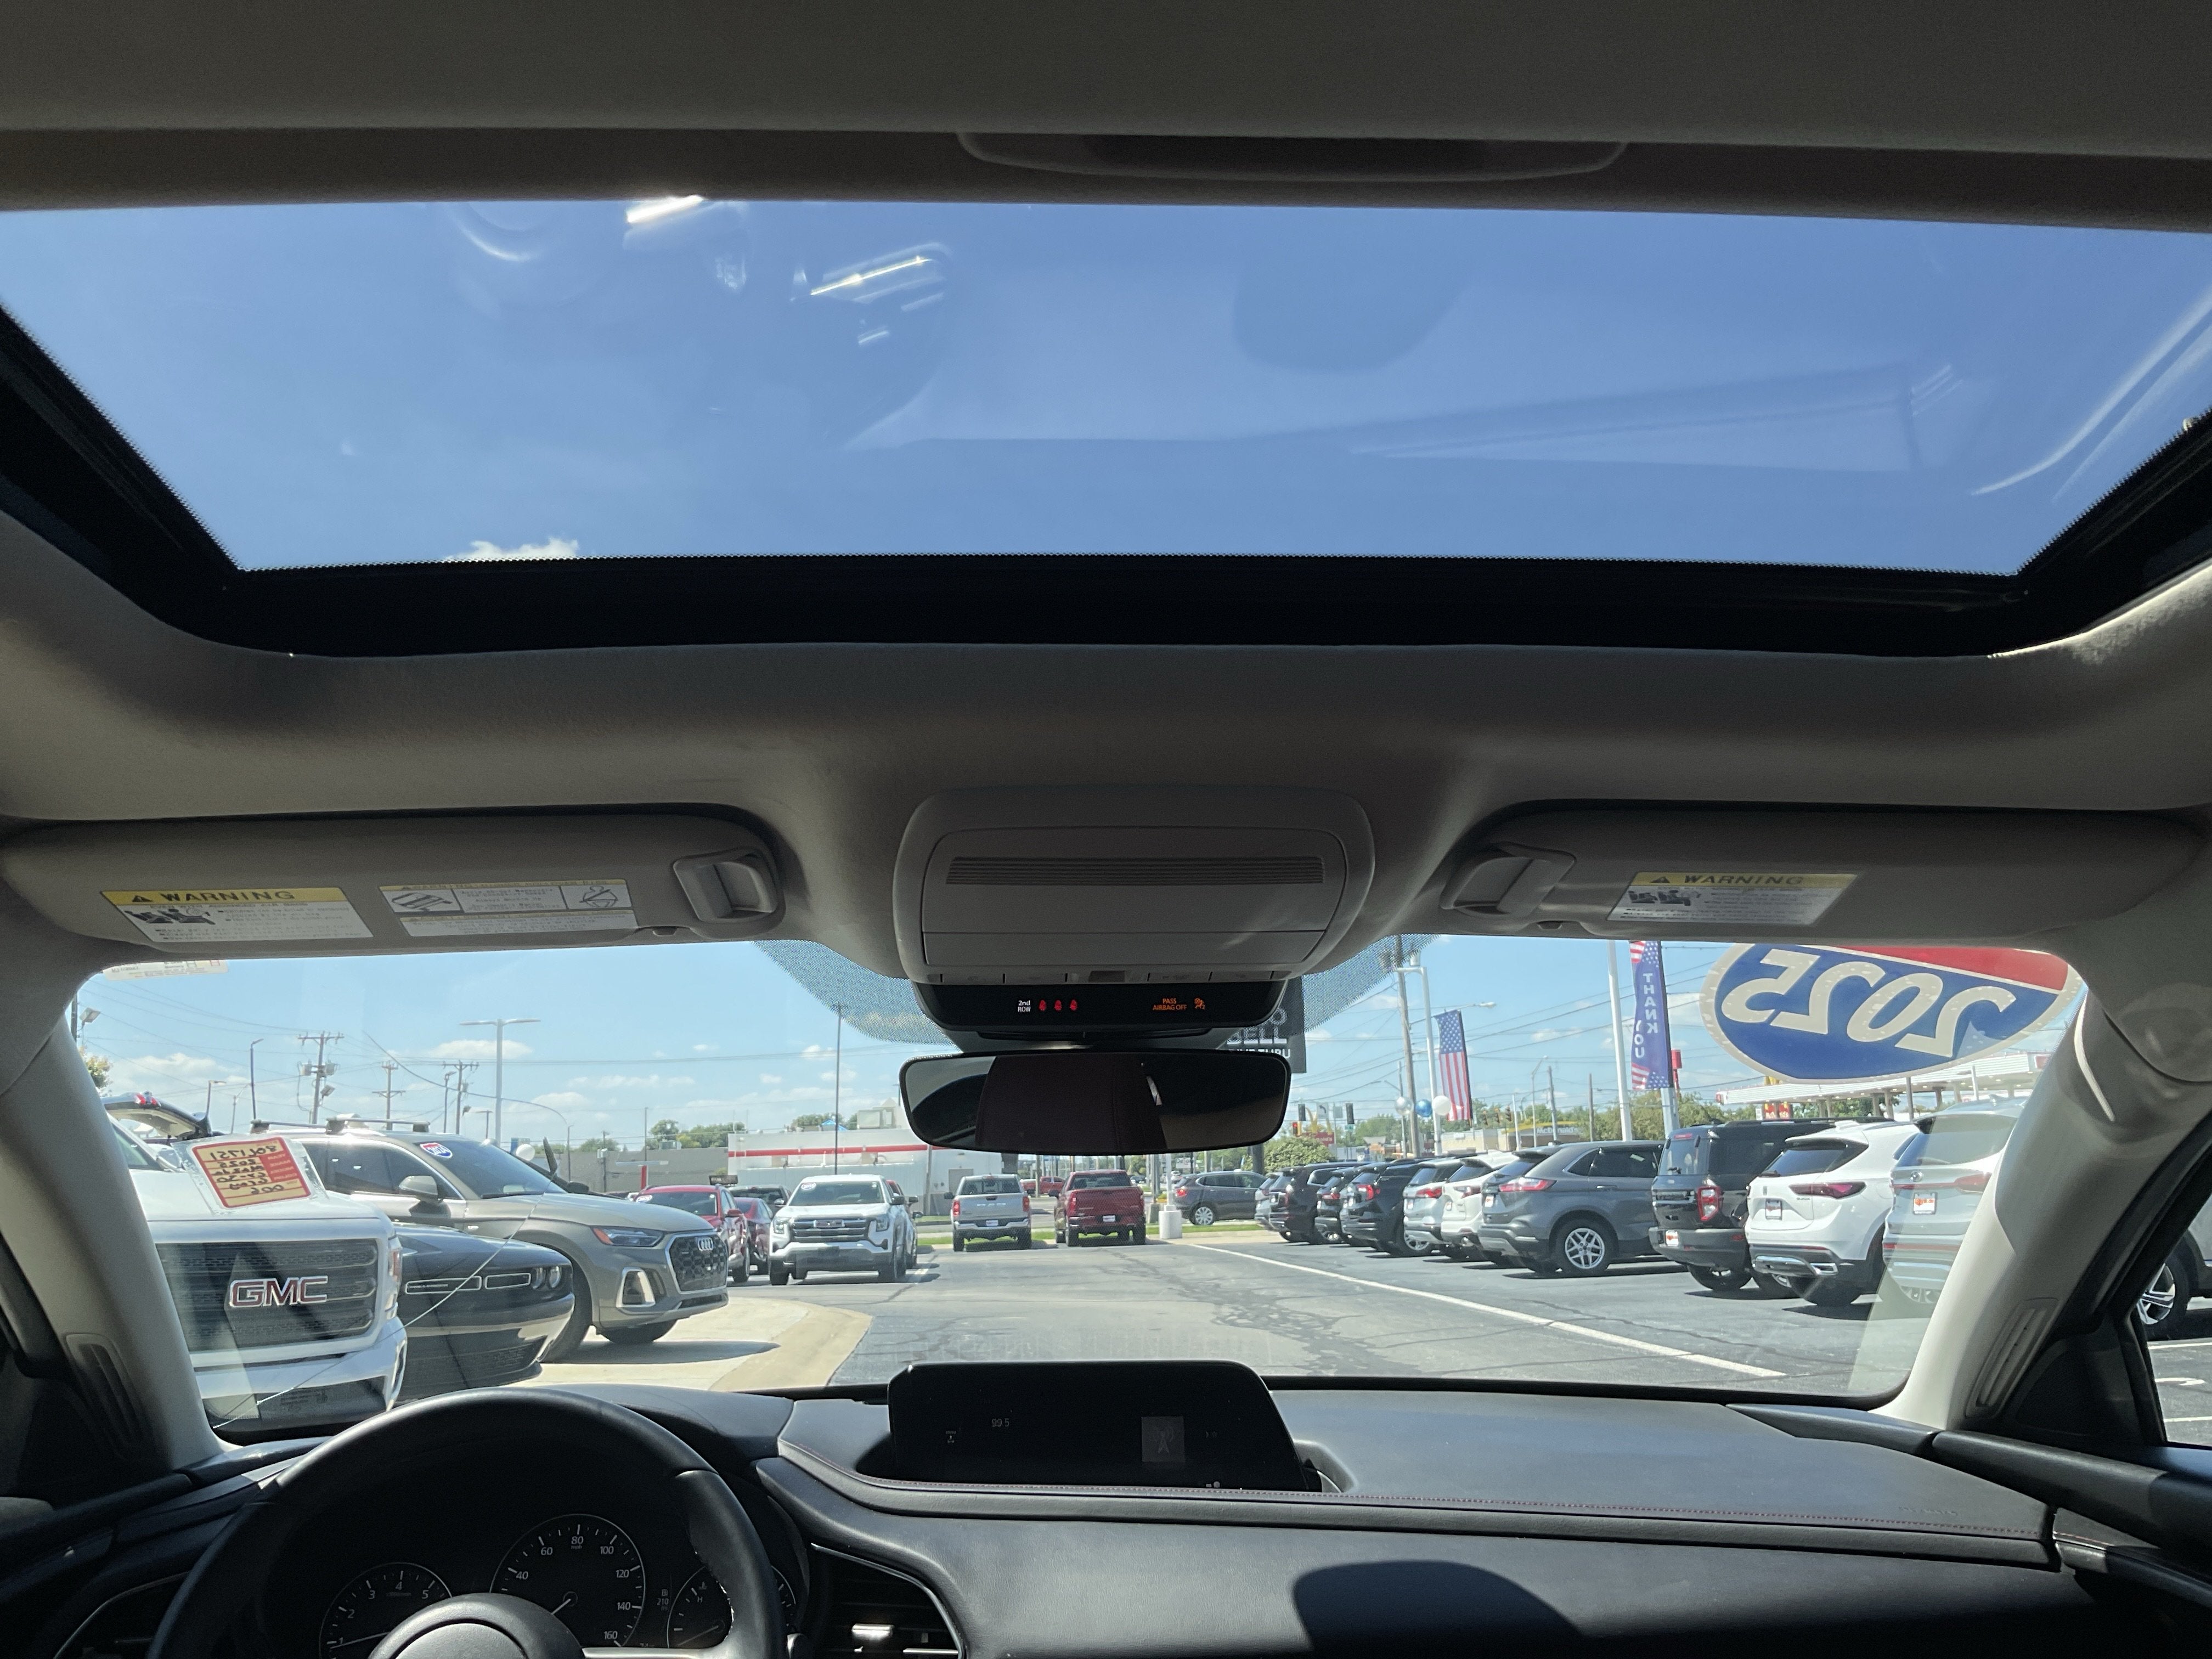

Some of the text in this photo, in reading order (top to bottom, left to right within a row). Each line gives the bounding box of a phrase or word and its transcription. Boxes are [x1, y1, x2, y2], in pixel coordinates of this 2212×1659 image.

[1684, 874, 1804, 885] WARNING
[160, 891, 295, 901] WARNING
[229, 1276, 329, 1308] GMC
[991, 1418, 1010, 1427] 99.5
[571, 1536, 584, 1544] 80
[540, 1547, 553, 1555] 60
[600, 1546, 614, 1554] 100
[516, 1571, 529, 1580] 40
[616, 1569, 629, 1578] 120
[395, 1581, 403, 1590] 4
[369, 1590, 376, 1600] 3
[422, 1589, 429, 1599] 5
[617, 1601, 631, 1611] 140
[347, 1609, 355, 1618] 2
[604, 1630, 618, 1639] 160
[338, 1637, 343, 1645] 1
